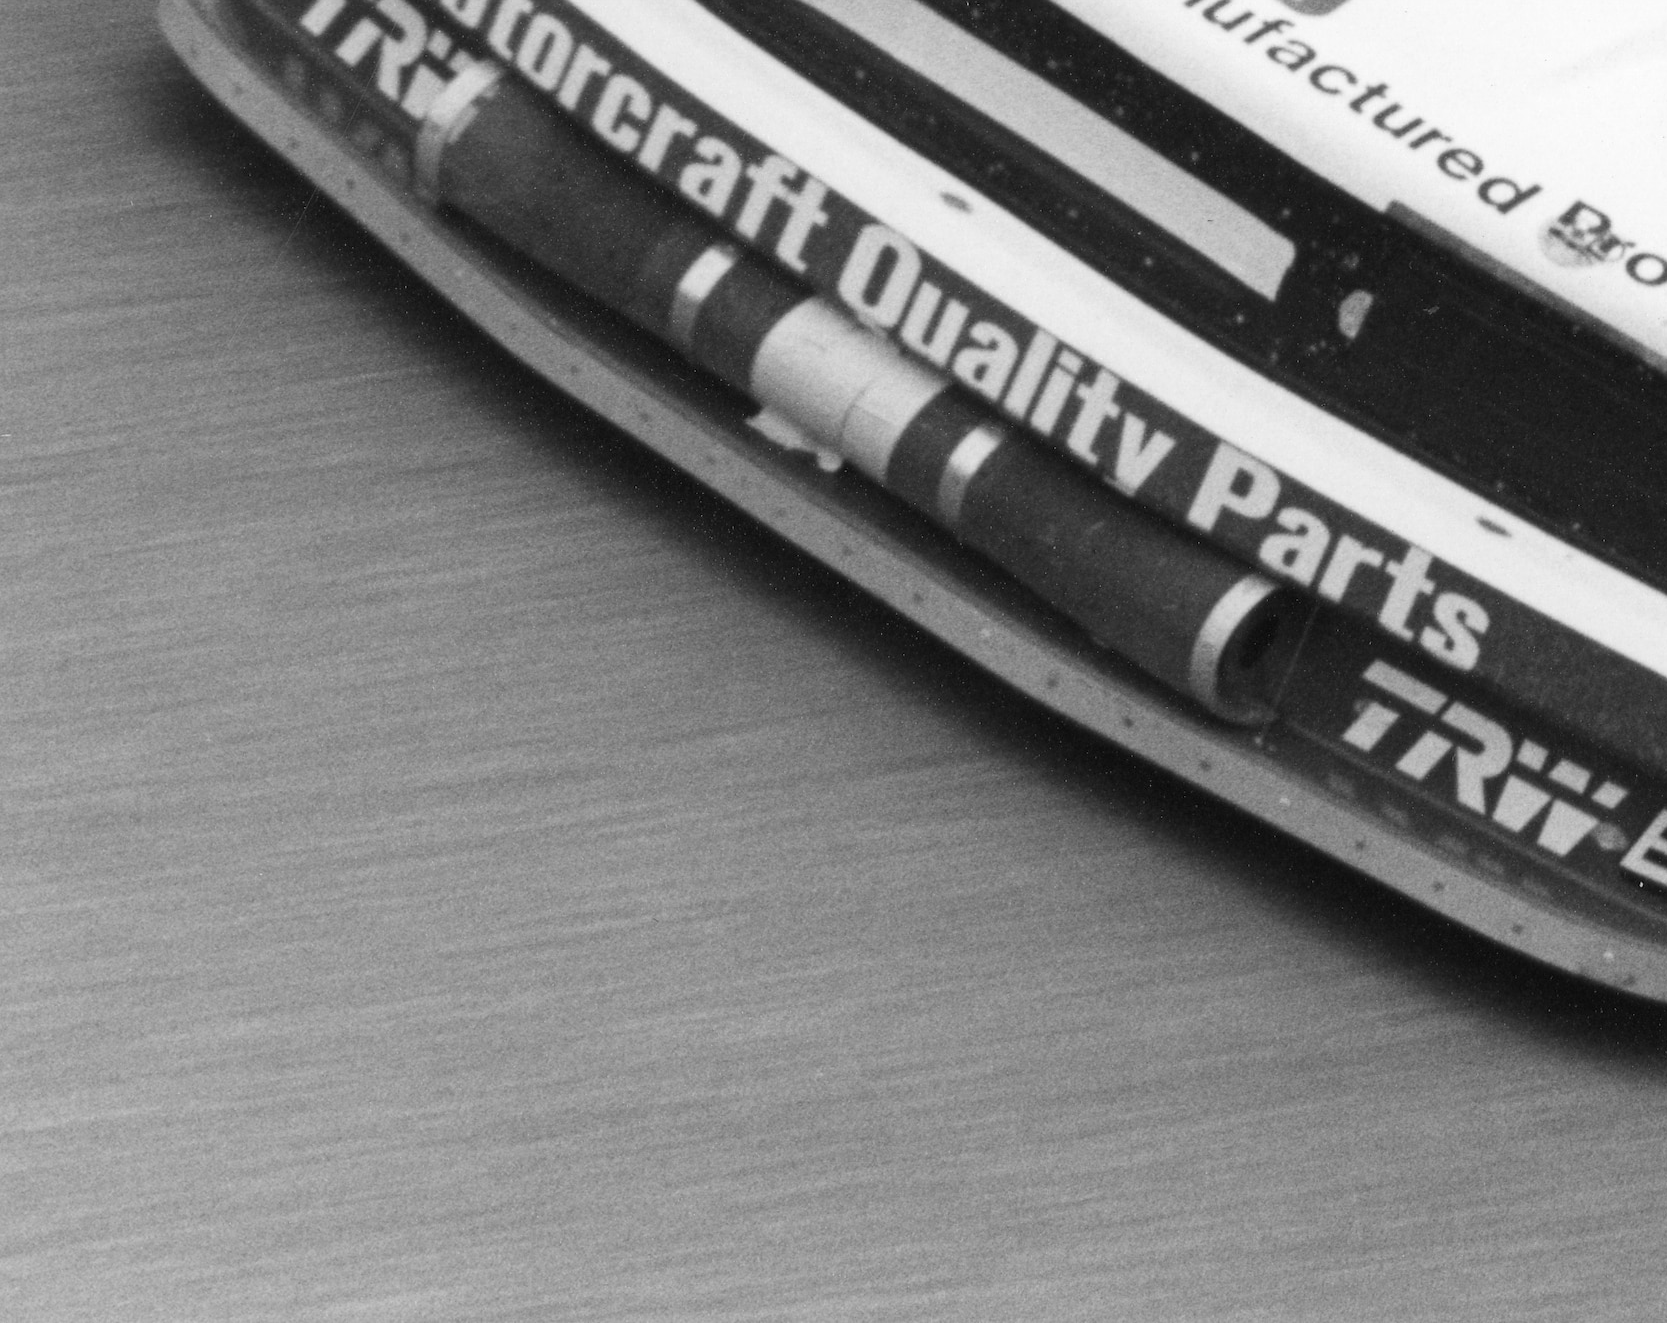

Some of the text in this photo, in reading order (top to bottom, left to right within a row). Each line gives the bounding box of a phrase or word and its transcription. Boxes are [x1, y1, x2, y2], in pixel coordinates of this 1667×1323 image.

[836, 222, 1177, 498] Quality
[1186, 441, 1492, 672] Parts
[1341, 658, 1629, 858] TRW
